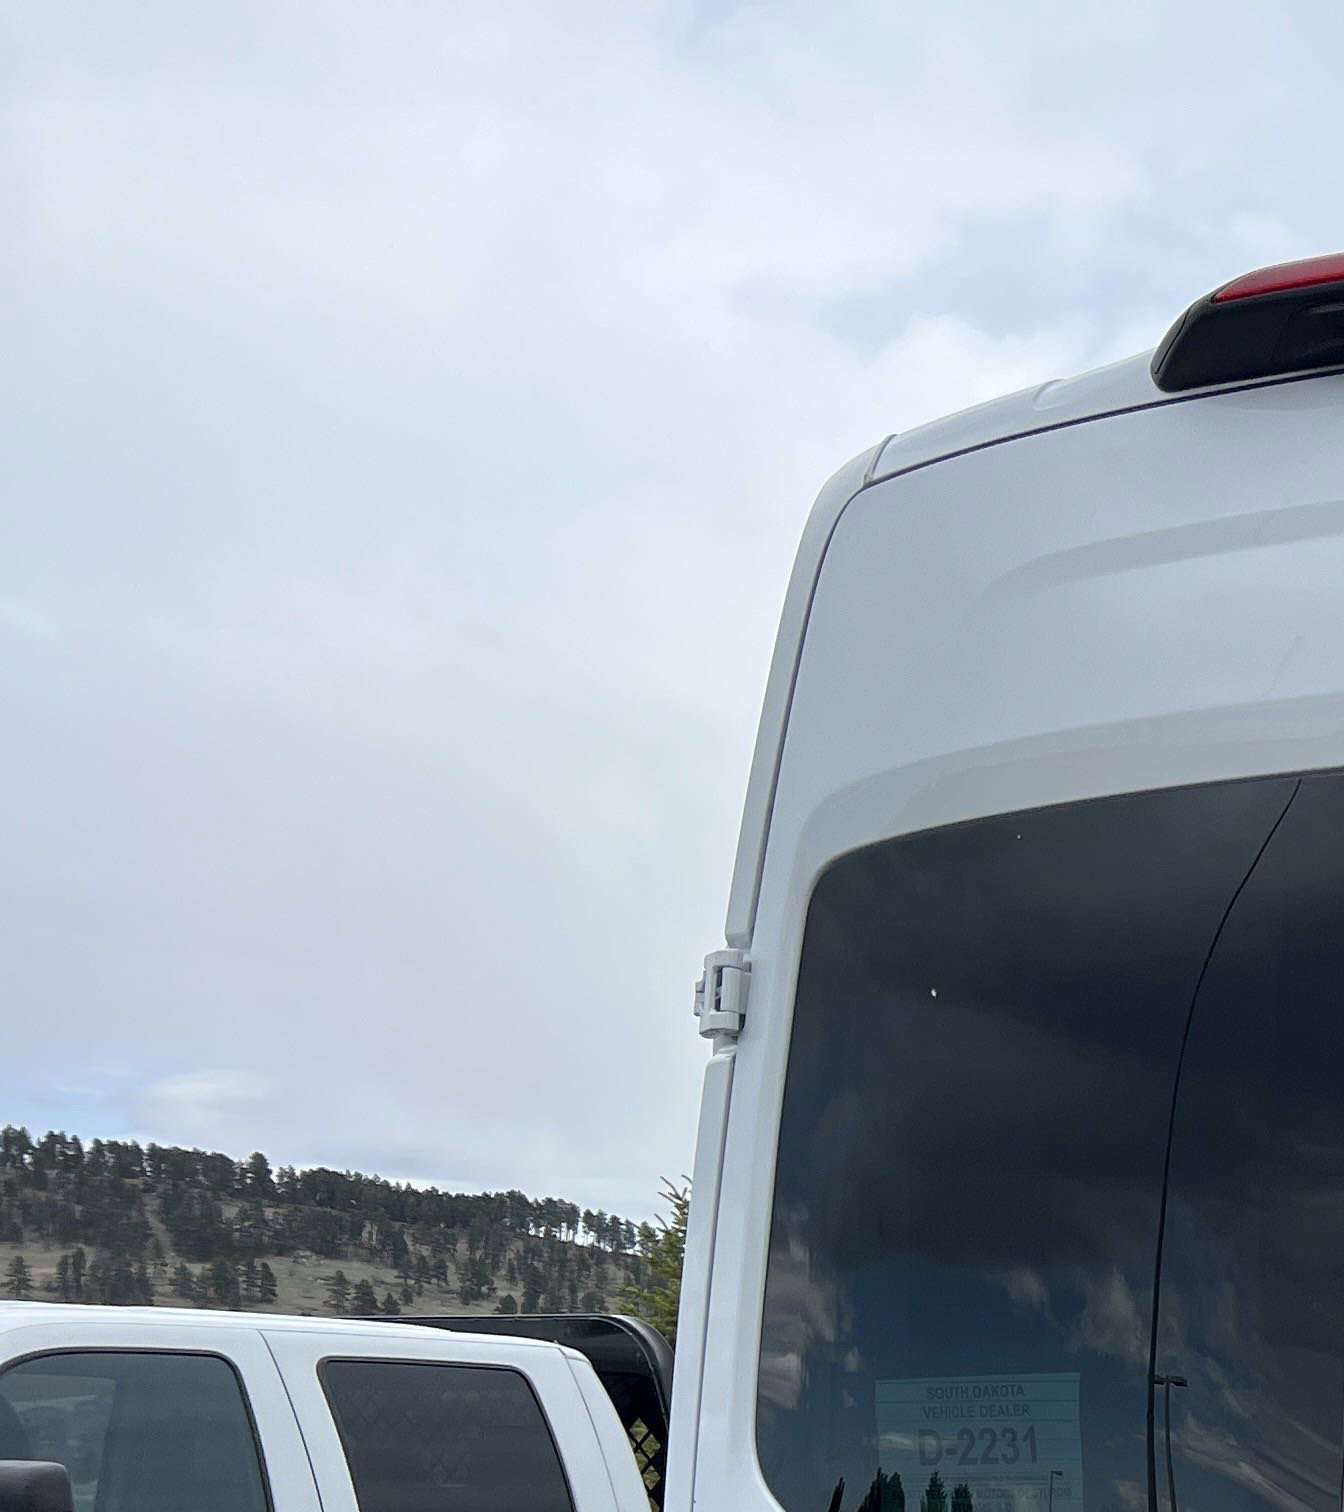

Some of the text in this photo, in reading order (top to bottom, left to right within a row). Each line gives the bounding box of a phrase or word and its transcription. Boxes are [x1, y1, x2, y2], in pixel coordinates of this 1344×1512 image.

[927, 1384, 1025, 1400] SOUTH DAKOTA
[923, 1404, 1032, 1420] VEHICLE DEALER
[917, 1425, 1038, 1467] D-2231
